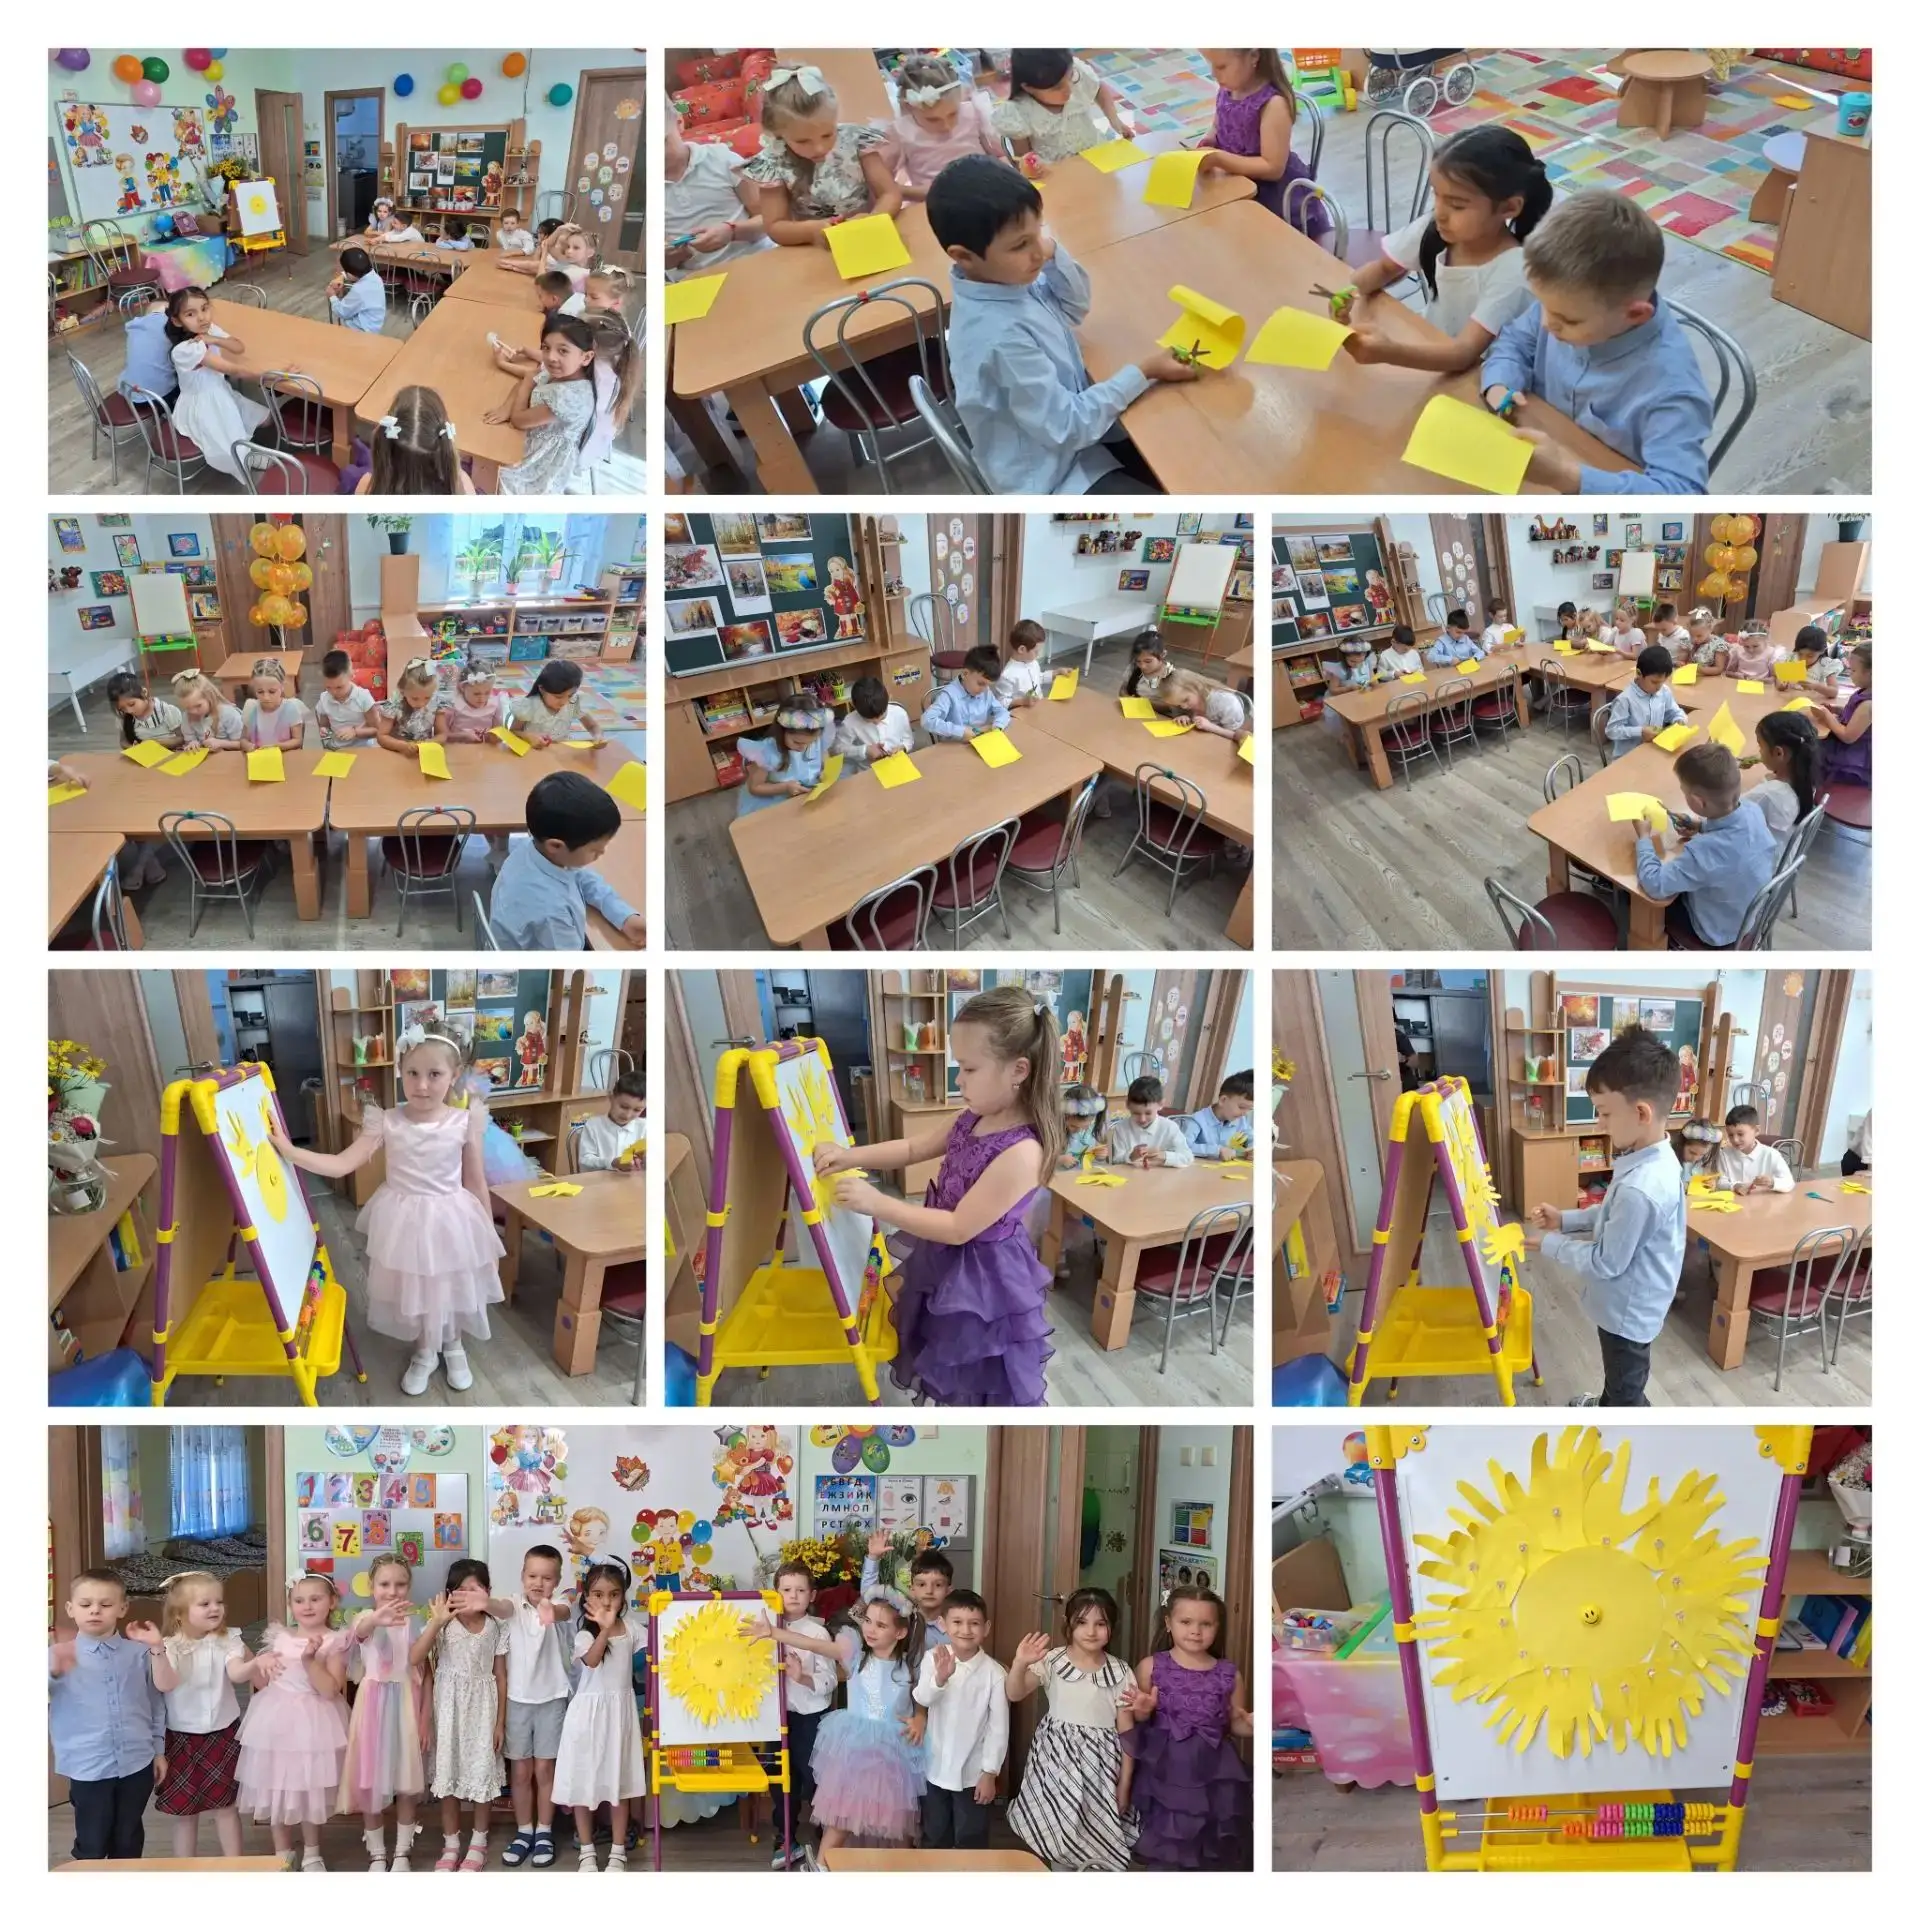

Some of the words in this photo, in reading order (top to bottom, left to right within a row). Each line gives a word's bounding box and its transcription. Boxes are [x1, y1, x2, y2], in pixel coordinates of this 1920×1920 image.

[303, 1475, 316, 1499] 1
[331, 1476, 347, 1503] 2
[359, 1479, 374, 1503] 3
[386, 1478, 403, 1503] 4
[414, 1478, 431, 1504] 5
[307, 1519, 323, 1543] 6
[338, 1528, 354, 1553] 7
[369, 1519, 386, 1545] 8
[437, 1524, 462, 1545] 10
[402, 1541, 419, 1566] 9
